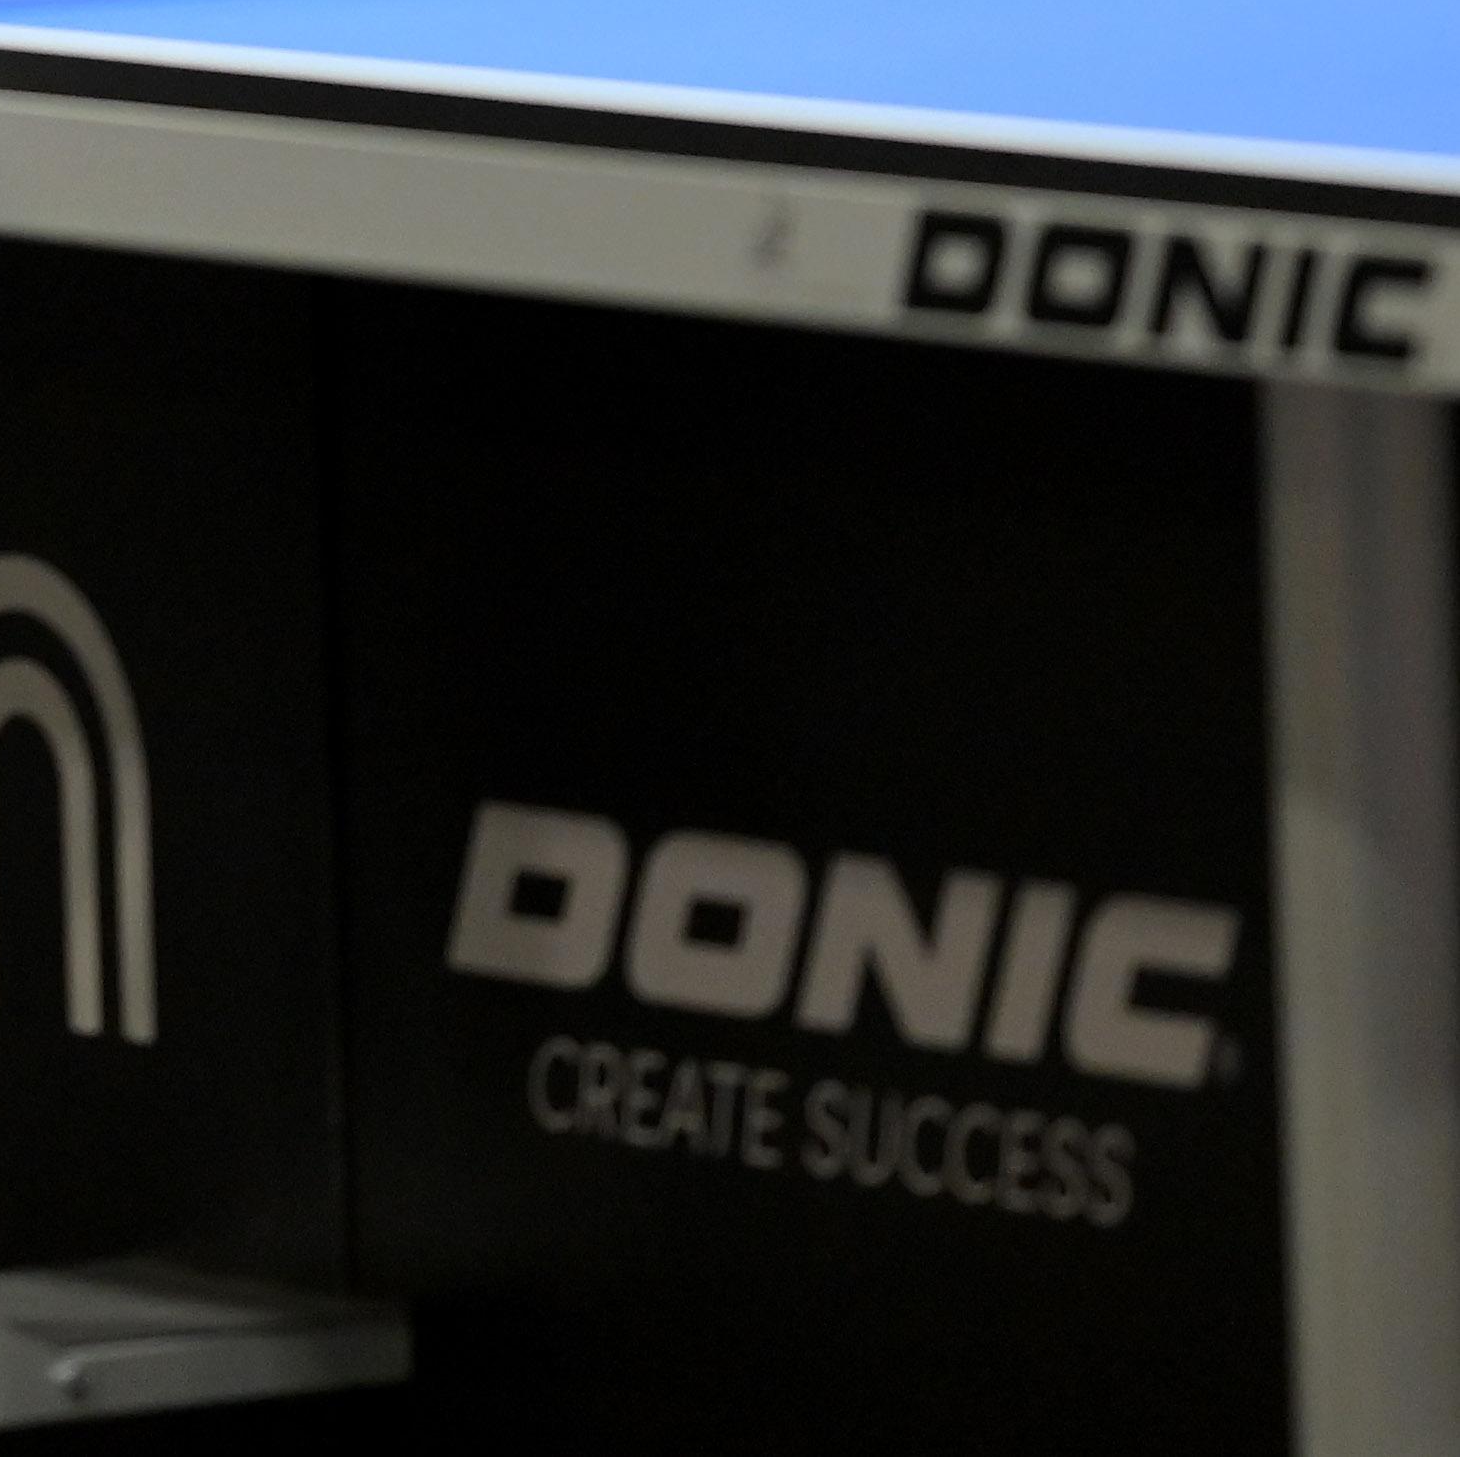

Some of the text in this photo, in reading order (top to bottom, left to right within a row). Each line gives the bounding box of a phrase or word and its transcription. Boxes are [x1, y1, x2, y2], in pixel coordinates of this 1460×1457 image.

[901, 206, 1437, 365] DONIC
[444, 799, 1242, 1092] DONIC
[526, 1033, 1138, 1228] CREATE SUCCESS
